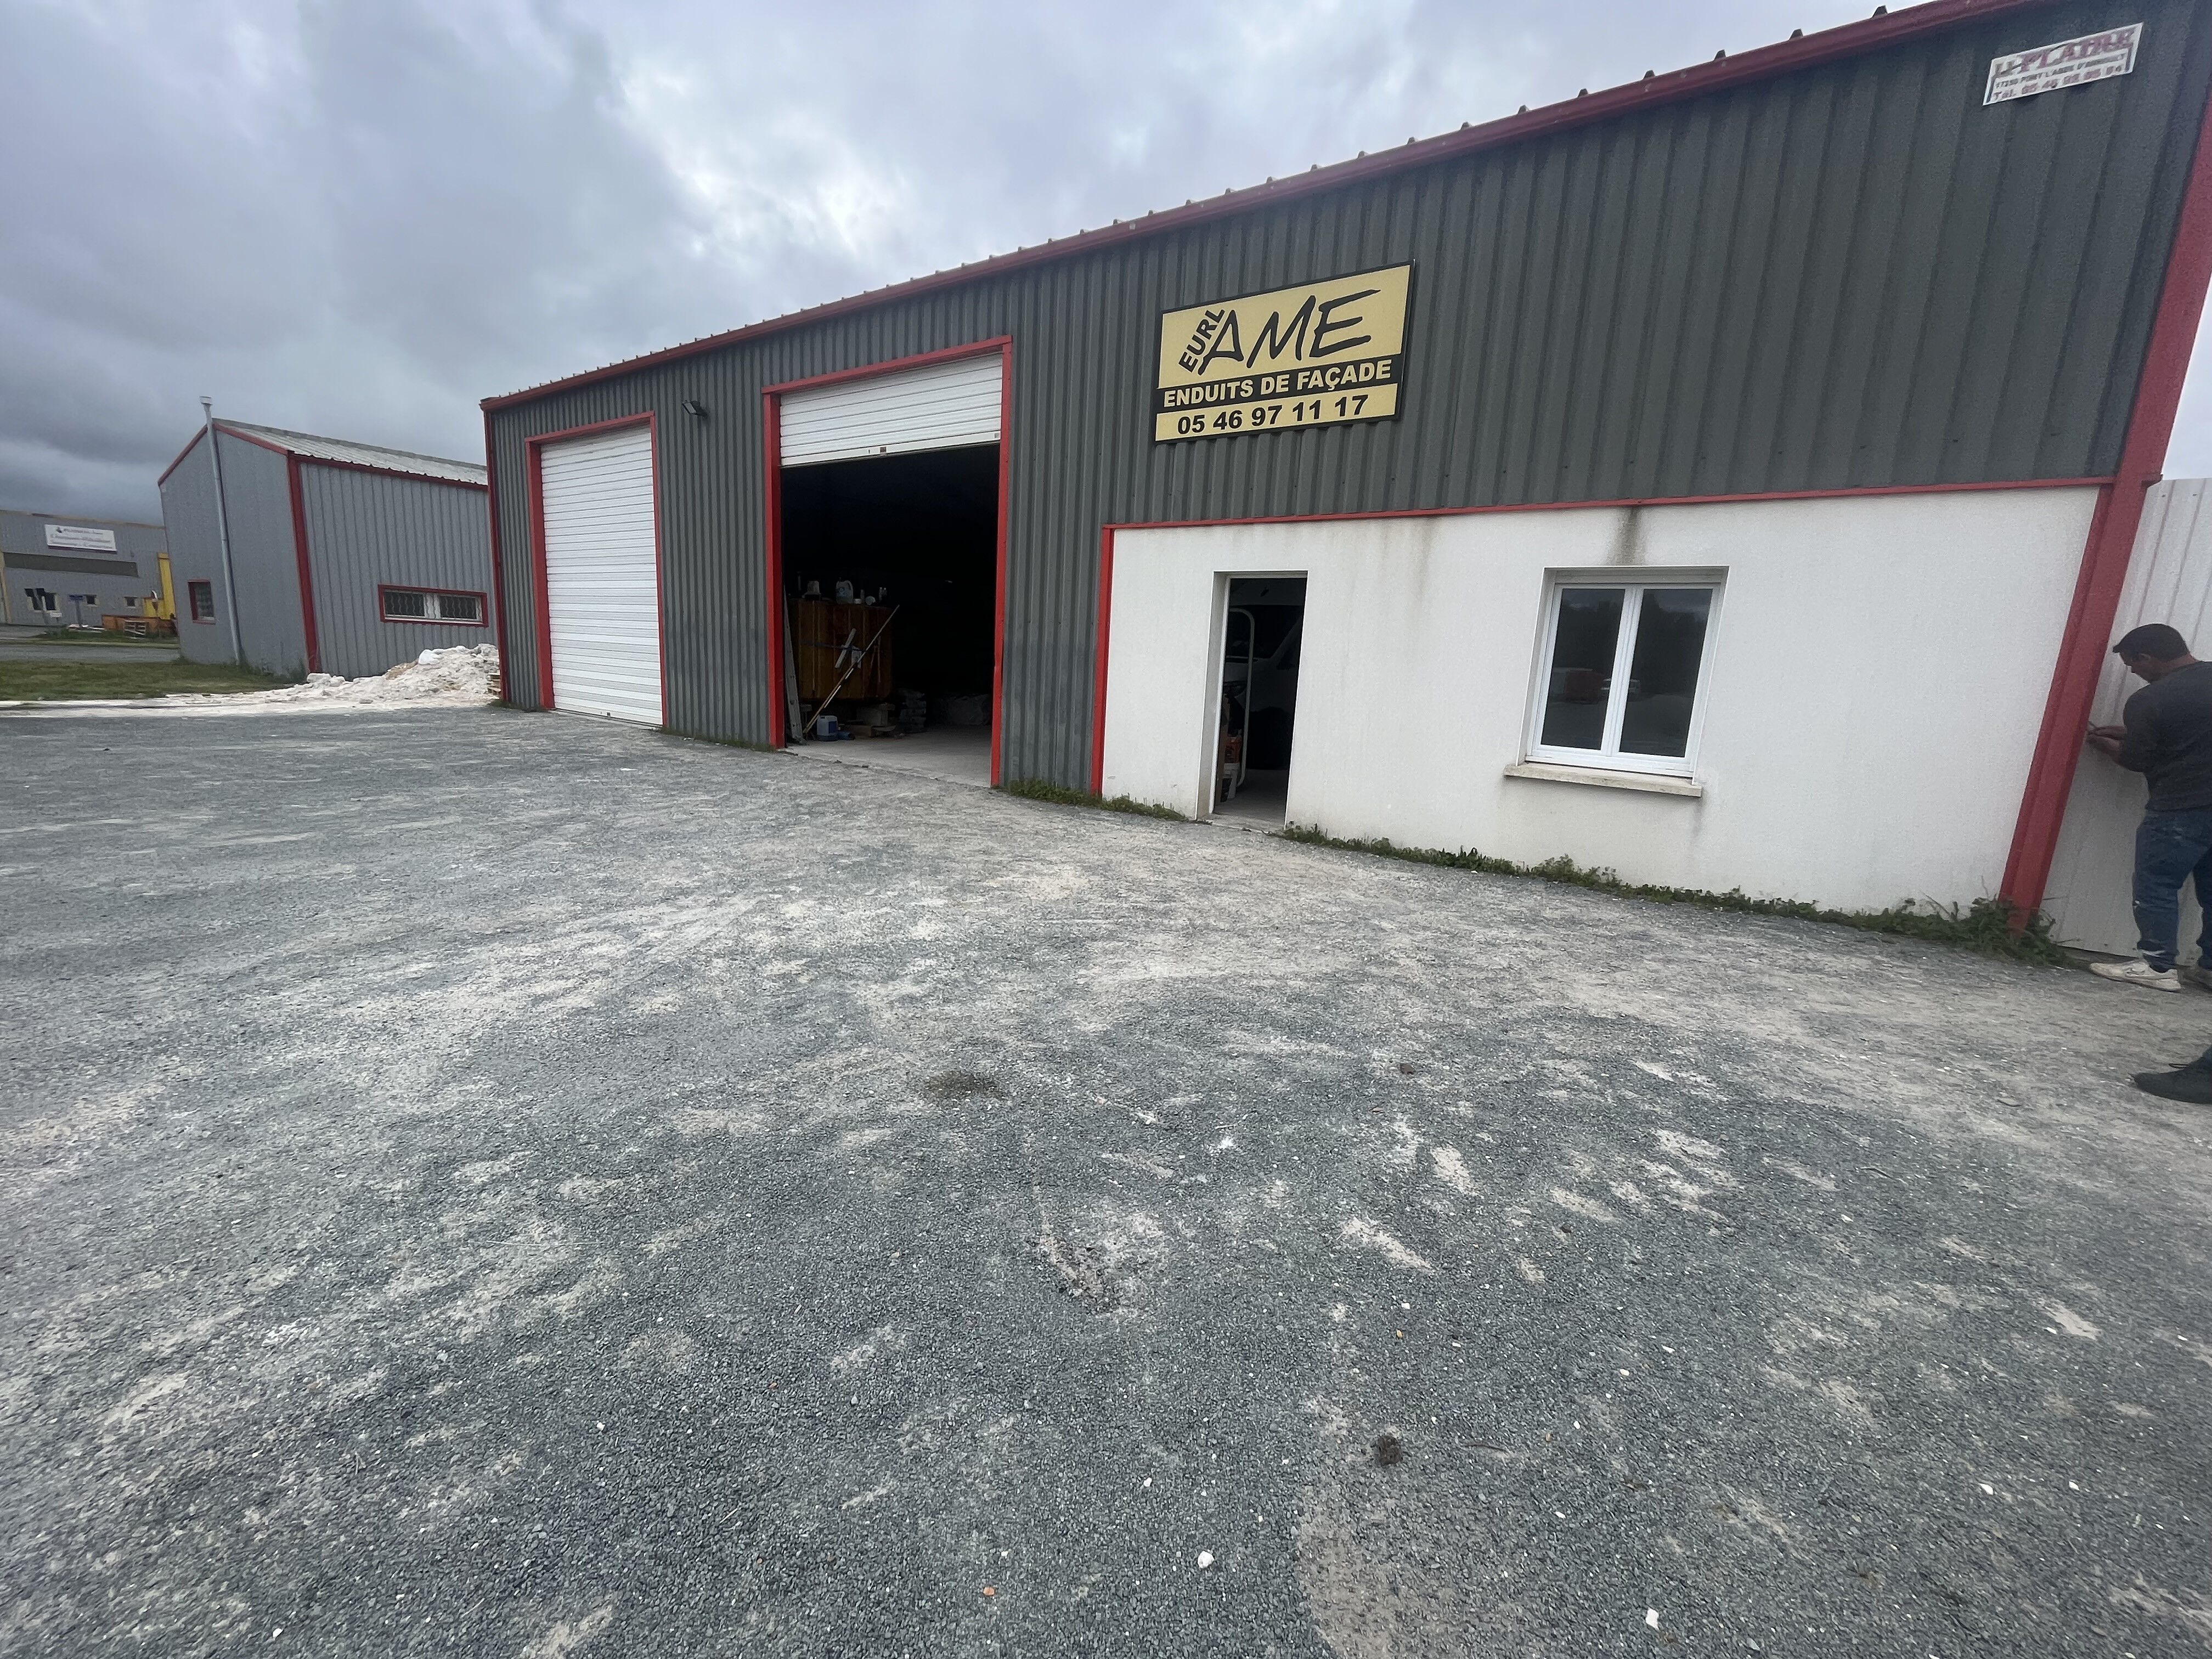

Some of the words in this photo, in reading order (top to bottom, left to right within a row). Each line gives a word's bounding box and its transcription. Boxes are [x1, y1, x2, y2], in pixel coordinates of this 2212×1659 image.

[1178, 309, 1225, 373] EURL
[1198, 289, 1381, 375] AME
[1164, 380, 1254, 407] ENDUITS
[1260, 374, 1290, 396] DE
[1296, 359, 1392, 391] FAÇADE
[1177, 416, 1205, 435] 05
[1213, 410, 1243, 430] 46
[1251, 405, 1283, 426] 97
[1293, 399, 1321, 421] 11
[1335, 394, 1369, 417] 17
